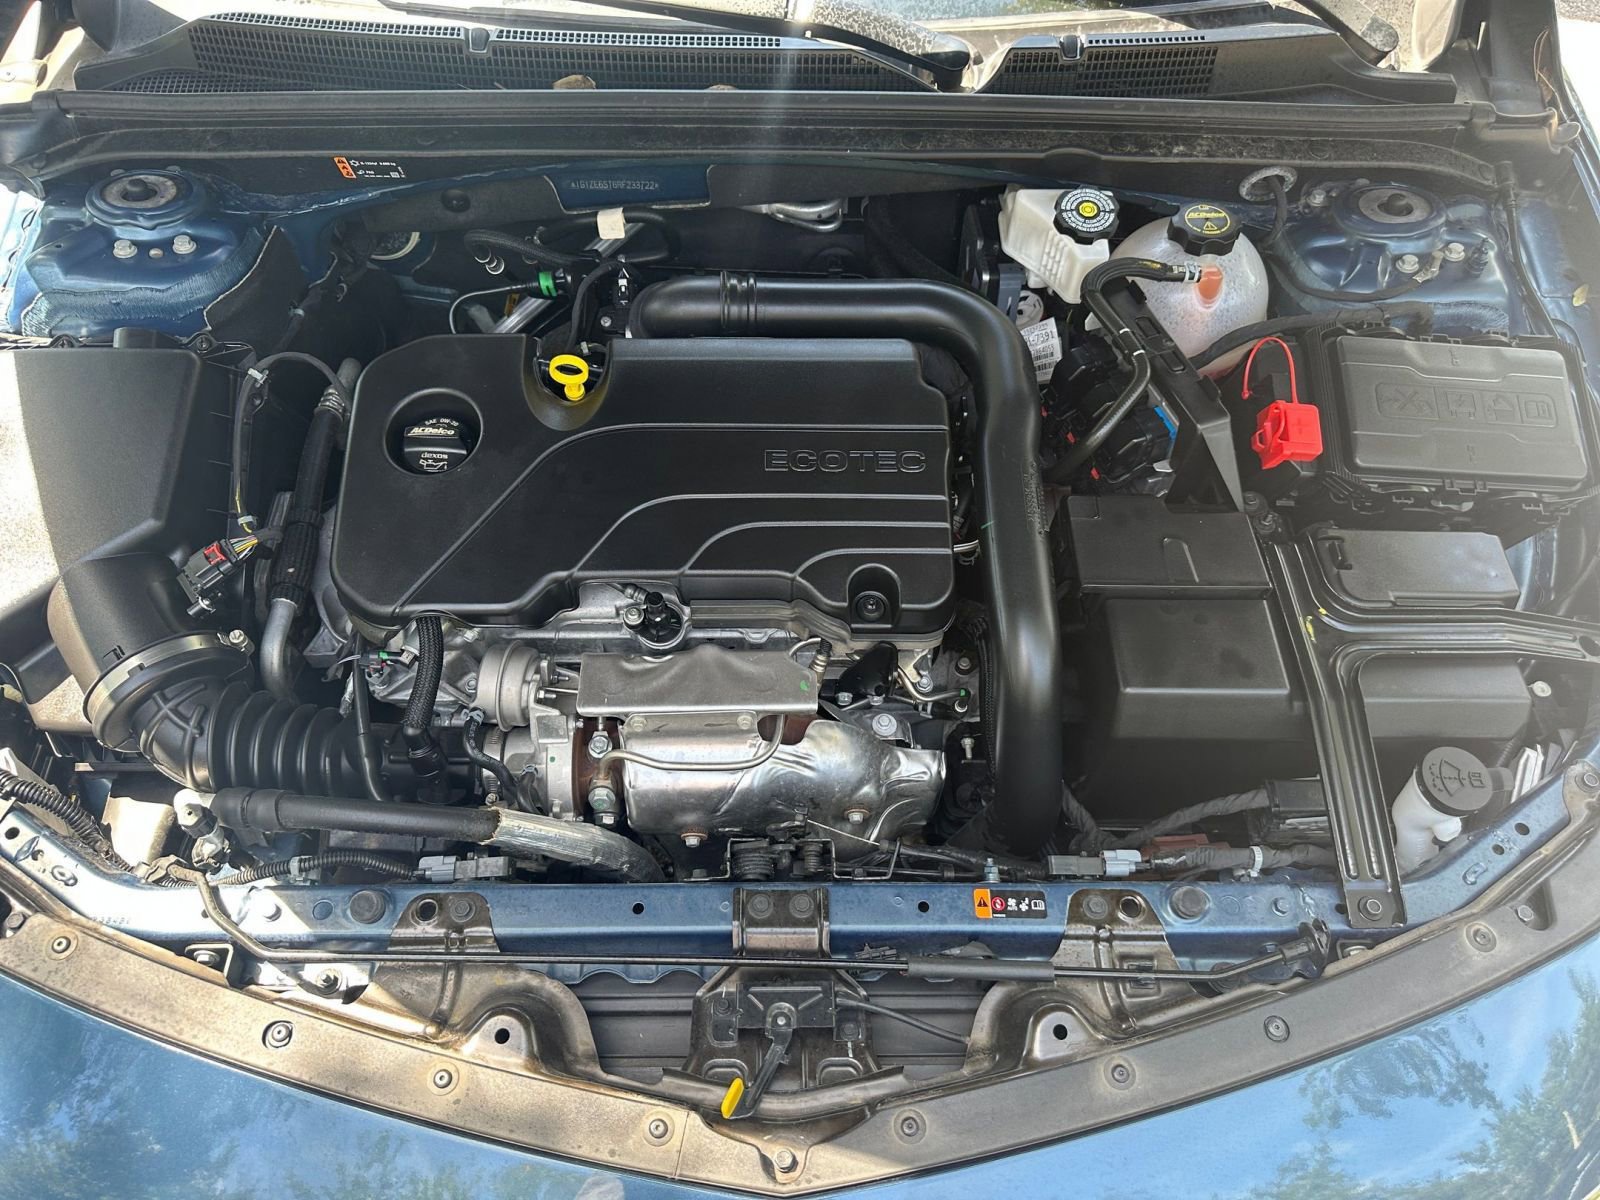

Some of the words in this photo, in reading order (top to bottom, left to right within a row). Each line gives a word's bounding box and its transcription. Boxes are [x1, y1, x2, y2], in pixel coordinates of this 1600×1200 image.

[424, 418, 437, 426] SAE
[408, 427, 455, 436] ACDelco
[421, 452, 448, 460] dexos
[764, 449, 926, 473] ECOTEC
